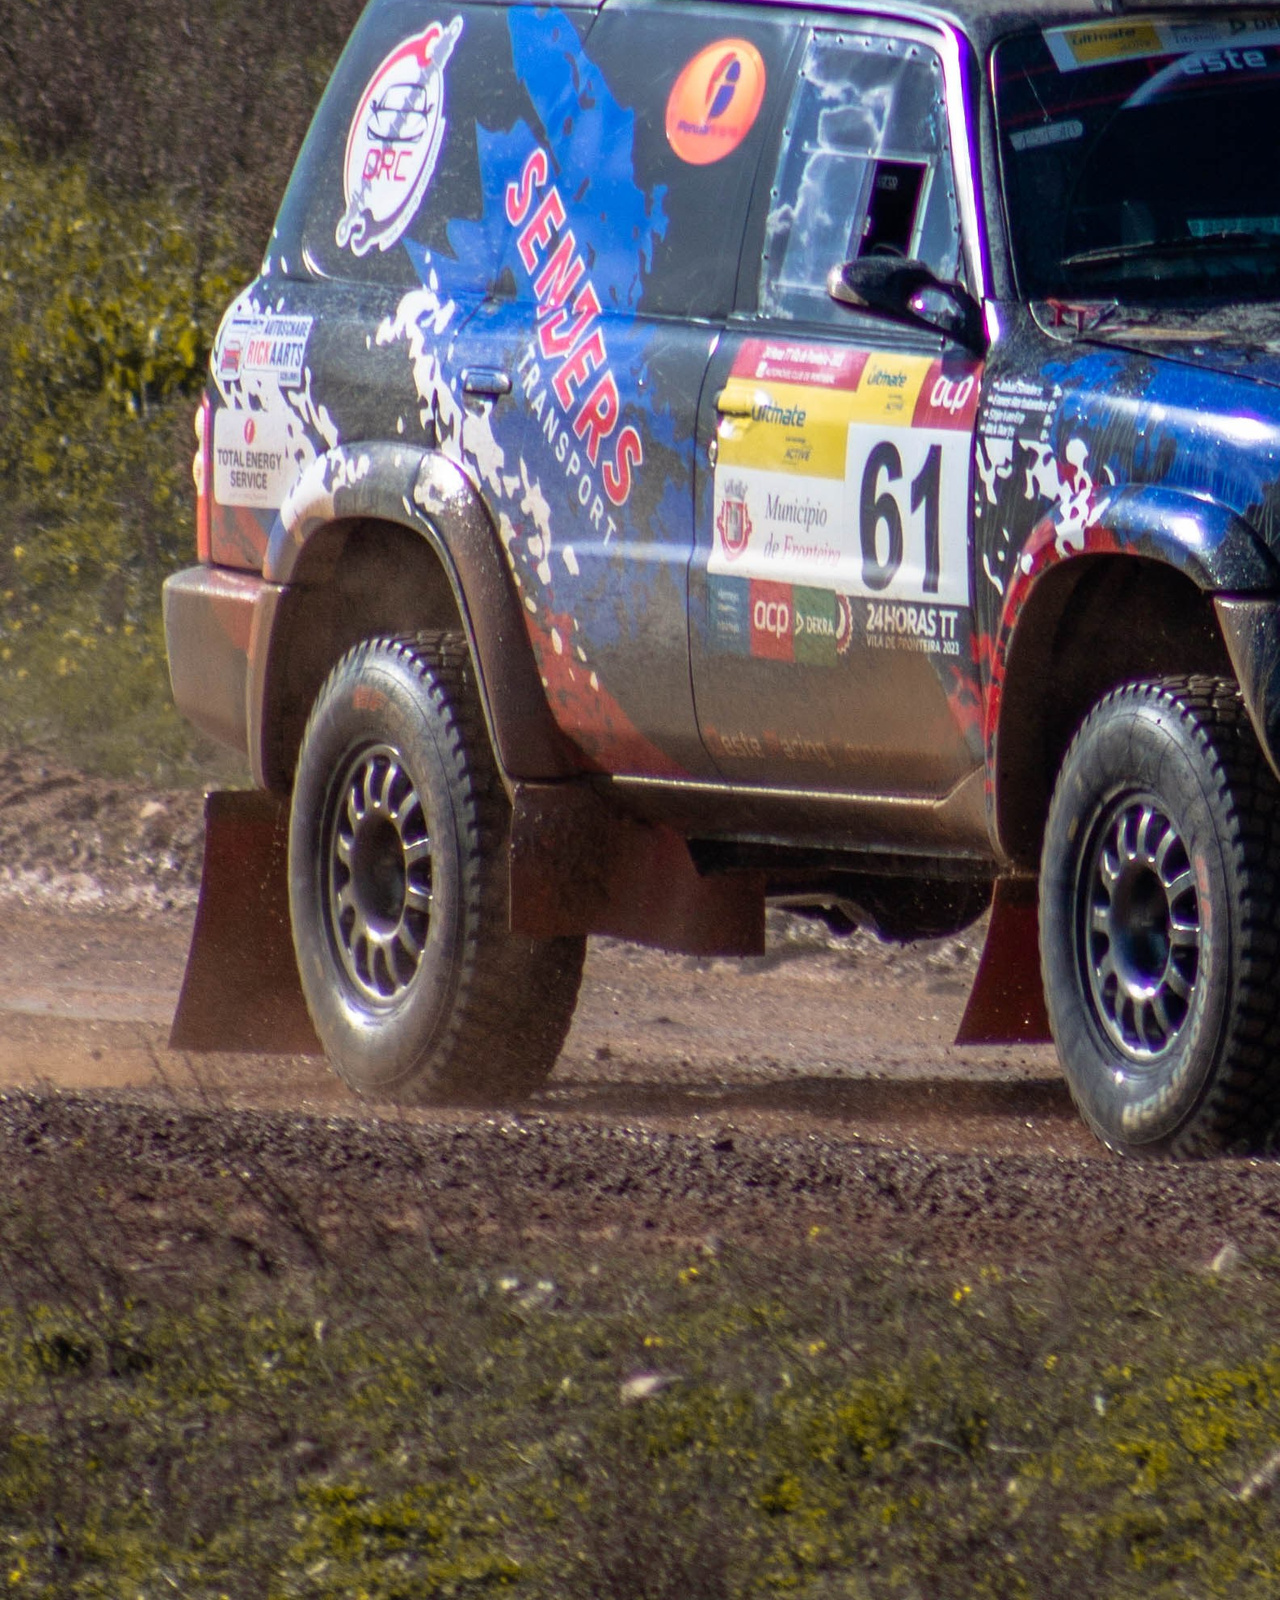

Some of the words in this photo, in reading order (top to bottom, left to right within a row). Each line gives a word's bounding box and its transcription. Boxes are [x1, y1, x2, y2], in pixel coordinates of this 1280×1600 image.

[1147, 49, 1267, 75] este
[930, 375, 974, 415] acp
[517, 343, 618, 545] TRANSPORT
[217, 448, 245, 468] TOTAL
[246, 451, 282, 474] ENERGY
[230, 471, 267, 490] SERVICE
[859, 440, 943, 595] 61
[754, 600, 789, 639] acp
[806, 615, 835, 636] DEKRA
[939, 610, 958, 639] TT
[866, 633, 884, 649] VILA
[885, 635, 896, 650] DE
[898, 636, 941, 654] FRONTEIRA
